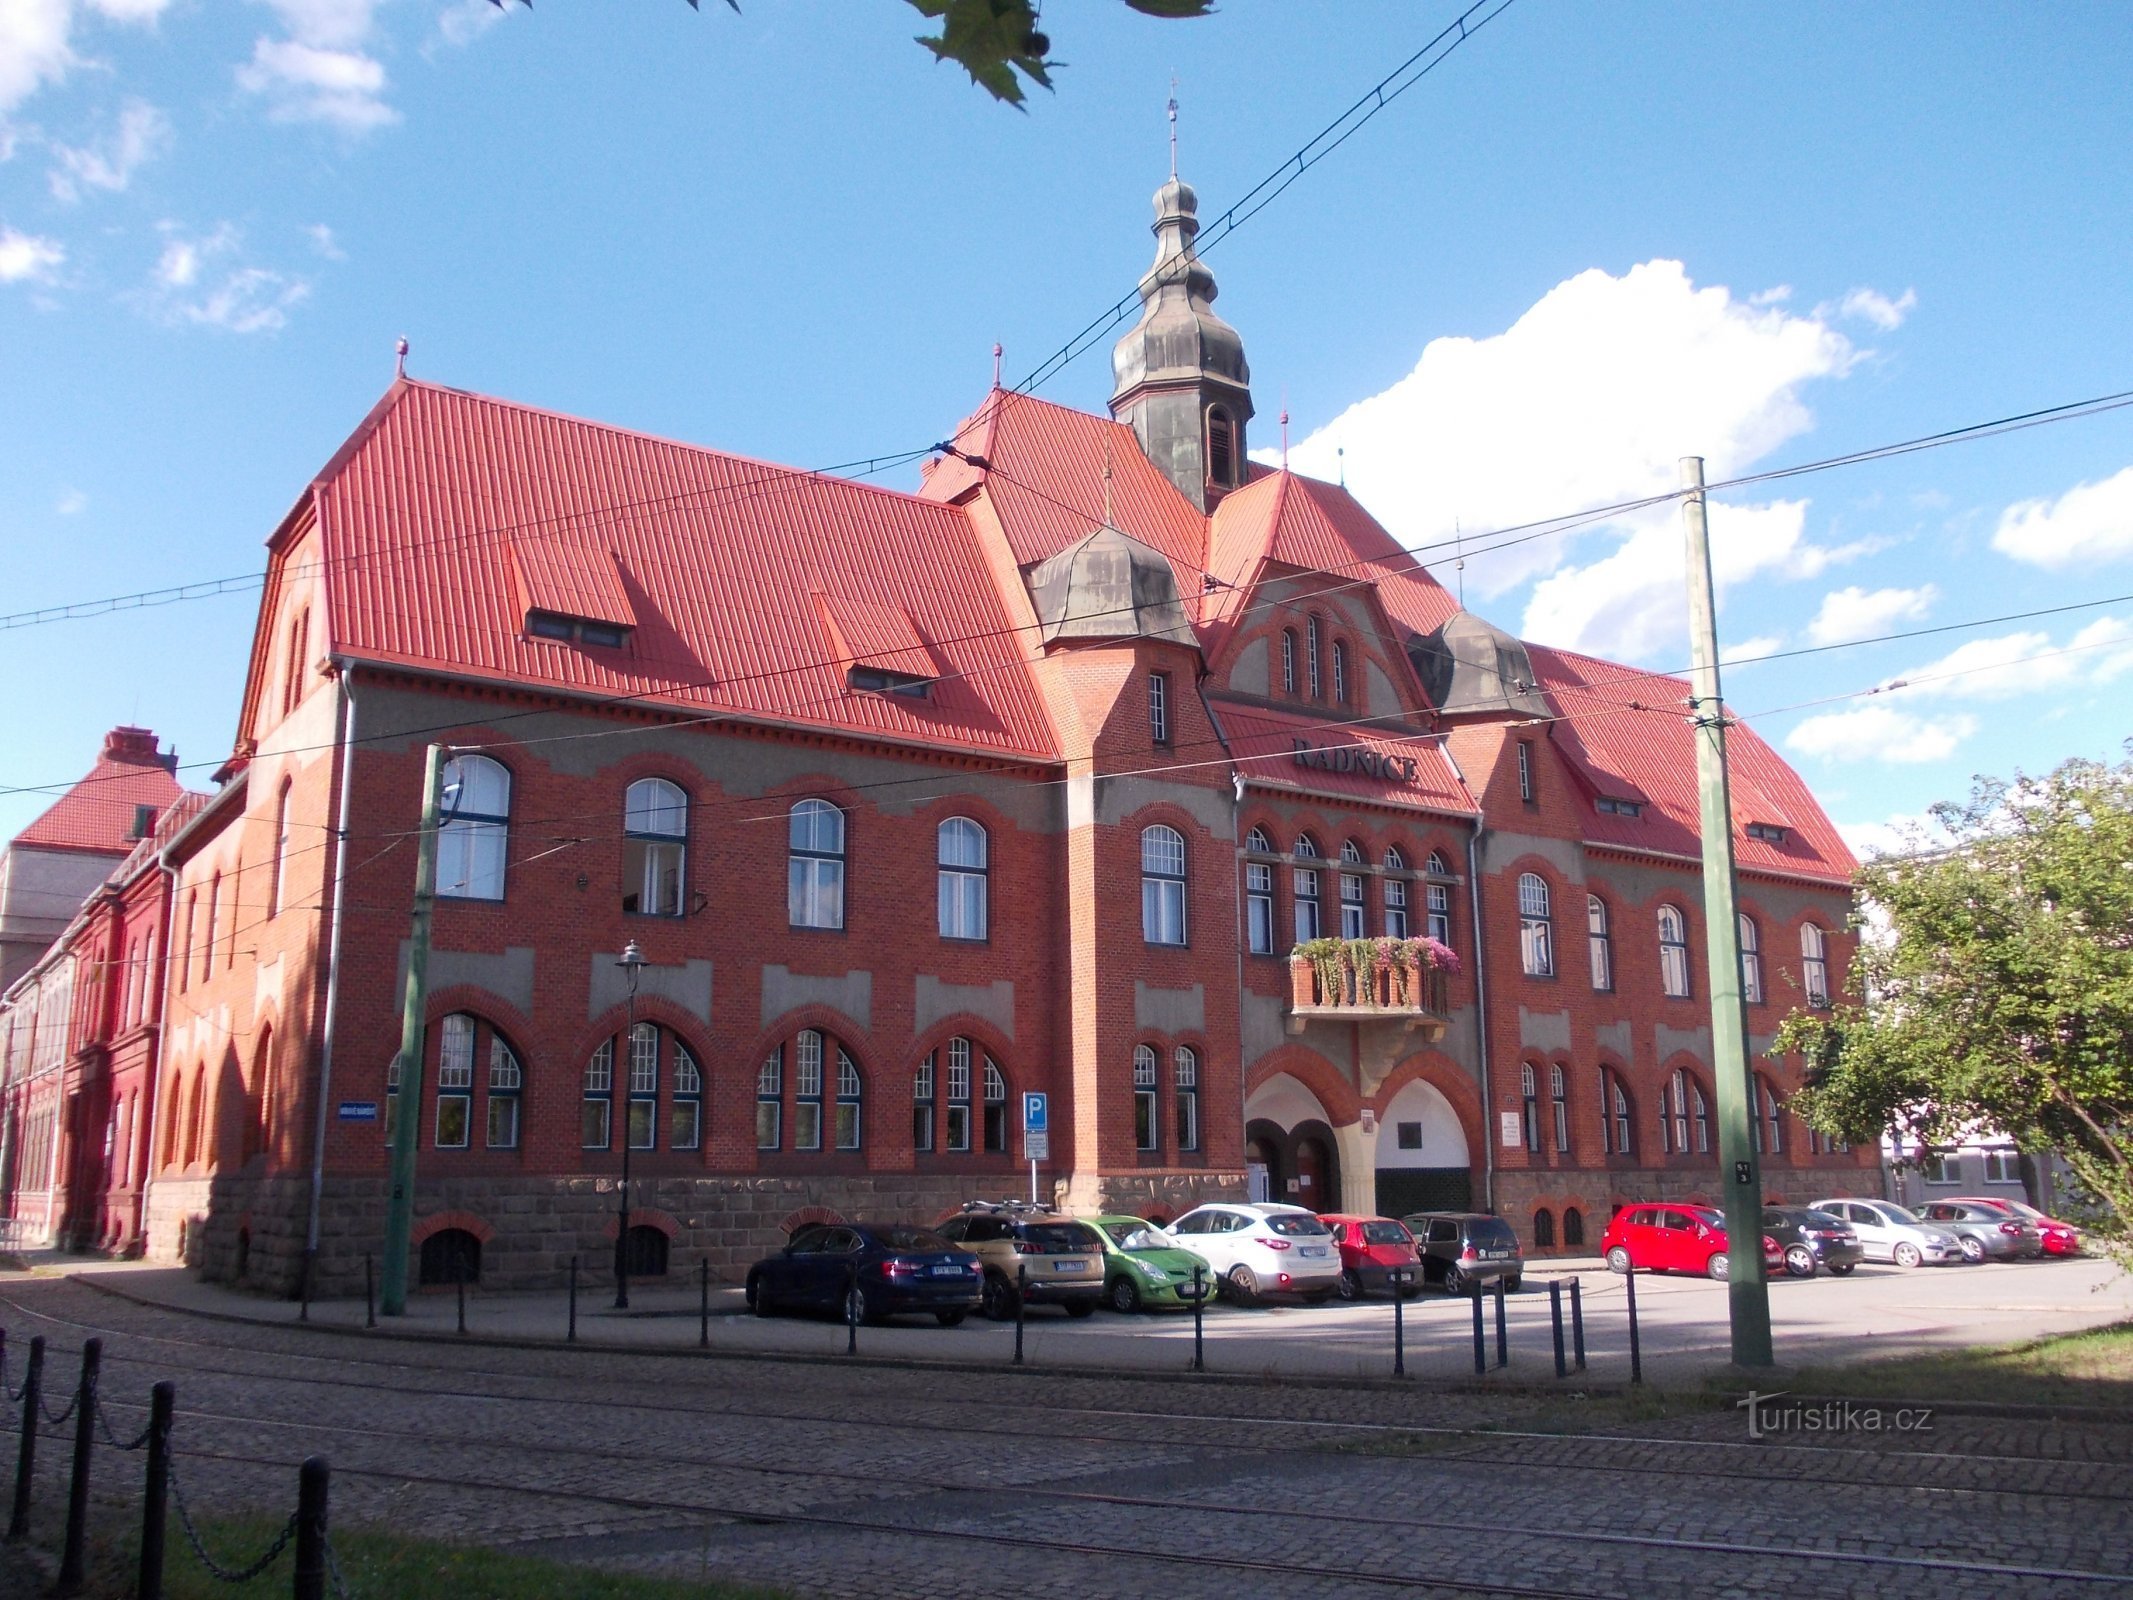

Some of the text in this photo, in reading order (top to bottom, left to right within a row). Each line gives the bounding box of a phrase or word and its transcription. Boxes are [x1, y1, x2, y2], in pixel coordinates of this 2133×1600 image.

[1292, 738, 1419, 782] RADNICE
[1029, 1098, 1042, 1119] P
[1740, 1174, 1747, 1182] 3
